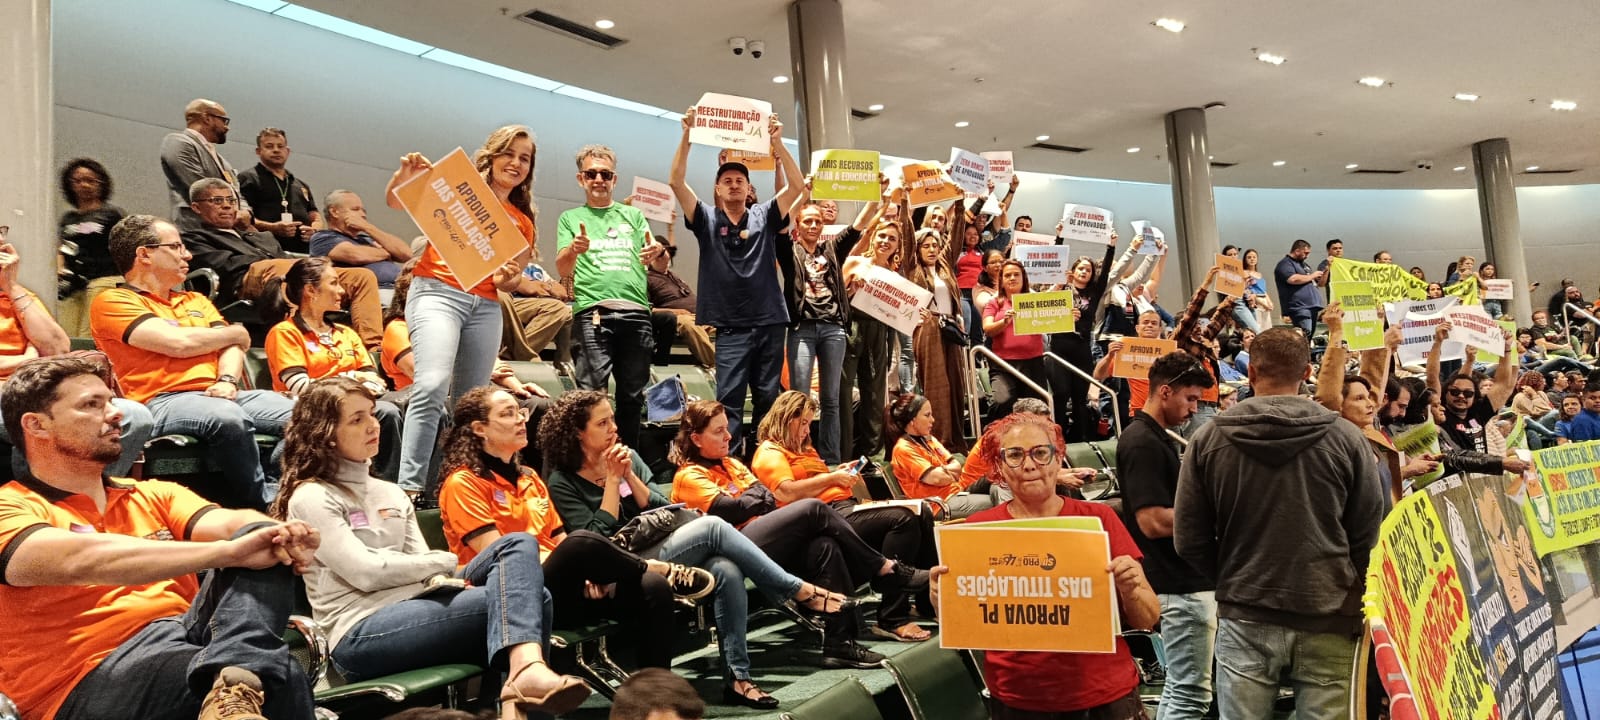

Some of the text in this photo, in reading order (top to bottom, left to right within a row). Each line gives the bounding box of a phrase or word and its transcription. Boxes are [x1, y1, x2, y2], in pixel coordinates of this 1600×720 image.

[697, 105, 761, 124] REESTRUTURAÇÃO
[696, 117, 744, 132] DA CARREIRA
[839, 159, 874, 171] RECURSOS
[916, 167, 937, 178] APROVA
[456, 181, 500, 239] APROVA PL
[431, 177, 495, 262] DAS TITULAÇÕES
[1069, 218, 1107, 230] DE APROVADOS
[1031, 260, 1061, 268] APROVADOS
[864, 283, 902, 310] DA CARREIRA
[1018, 298, 1067, 310] MAIS RECURSOS
[1129, 345, 1154, 354] APROVA
[956, 568, 1093, 602] DAS TITULAÇÕES
[978, 603, 1071, 626] APROVA PL
